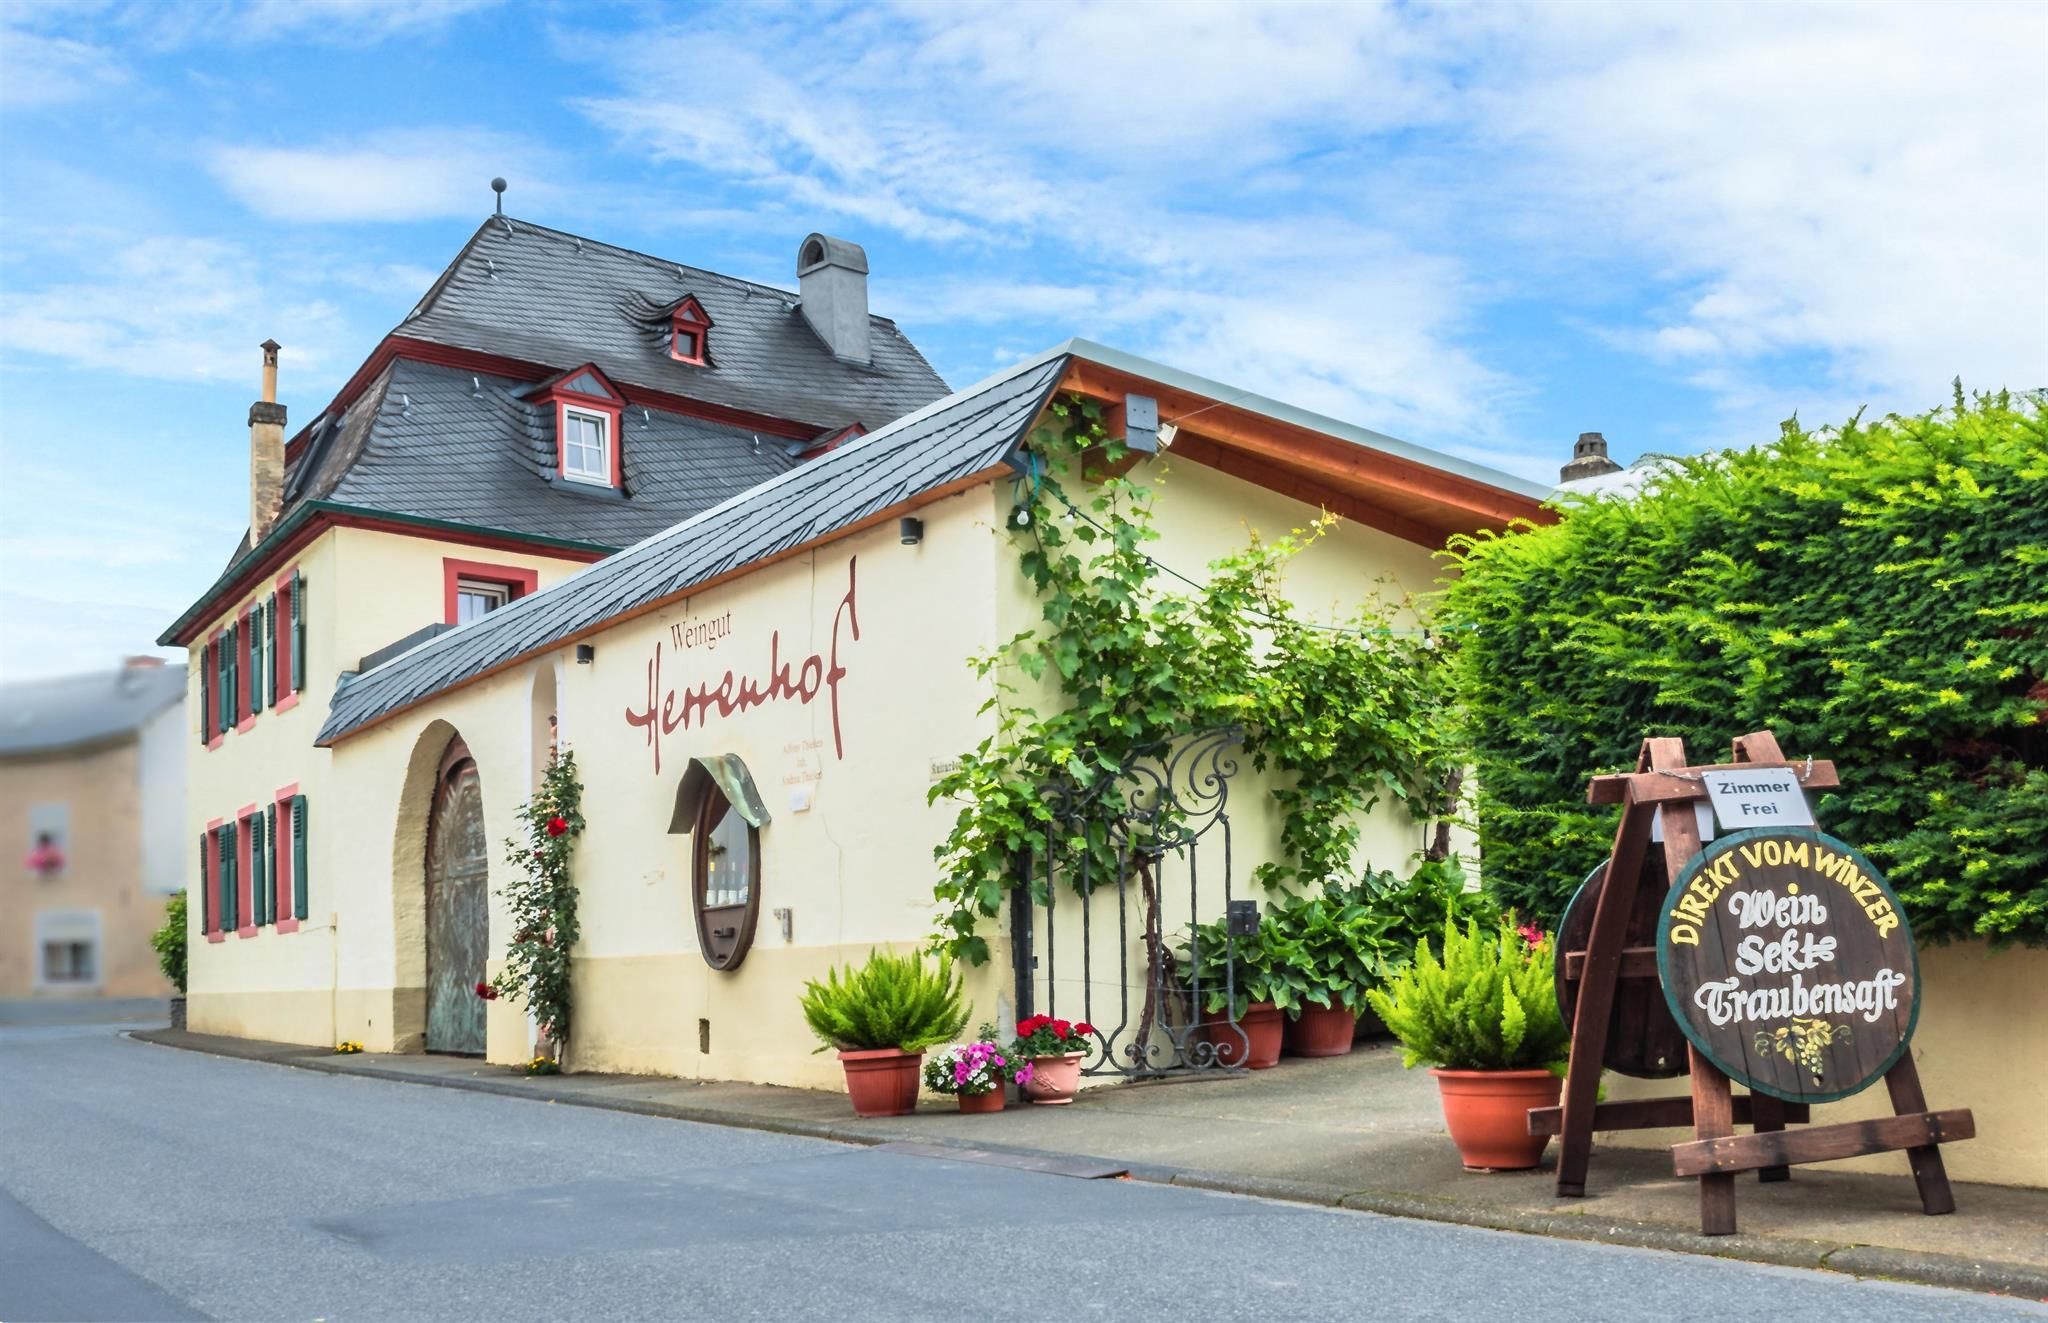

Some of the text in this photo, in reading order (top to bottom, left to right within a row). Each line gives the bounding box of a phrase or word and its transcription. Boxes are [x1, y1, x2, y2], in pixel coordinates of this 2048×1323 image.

[670, 609, 731, 652] Weingut
[625, 554, 860, 776] Herrenhof
[1718, 782, 1791, 794] Zimmer
[1740, 802, 1779, 815] Frei
[1740, 840, 1809, 869] VOM
[1728, 883, 1828, 930] Wein
[1735, 928, 1838, 976] Sekt
[1694, 968, 1906, 1027] Traubensaft
